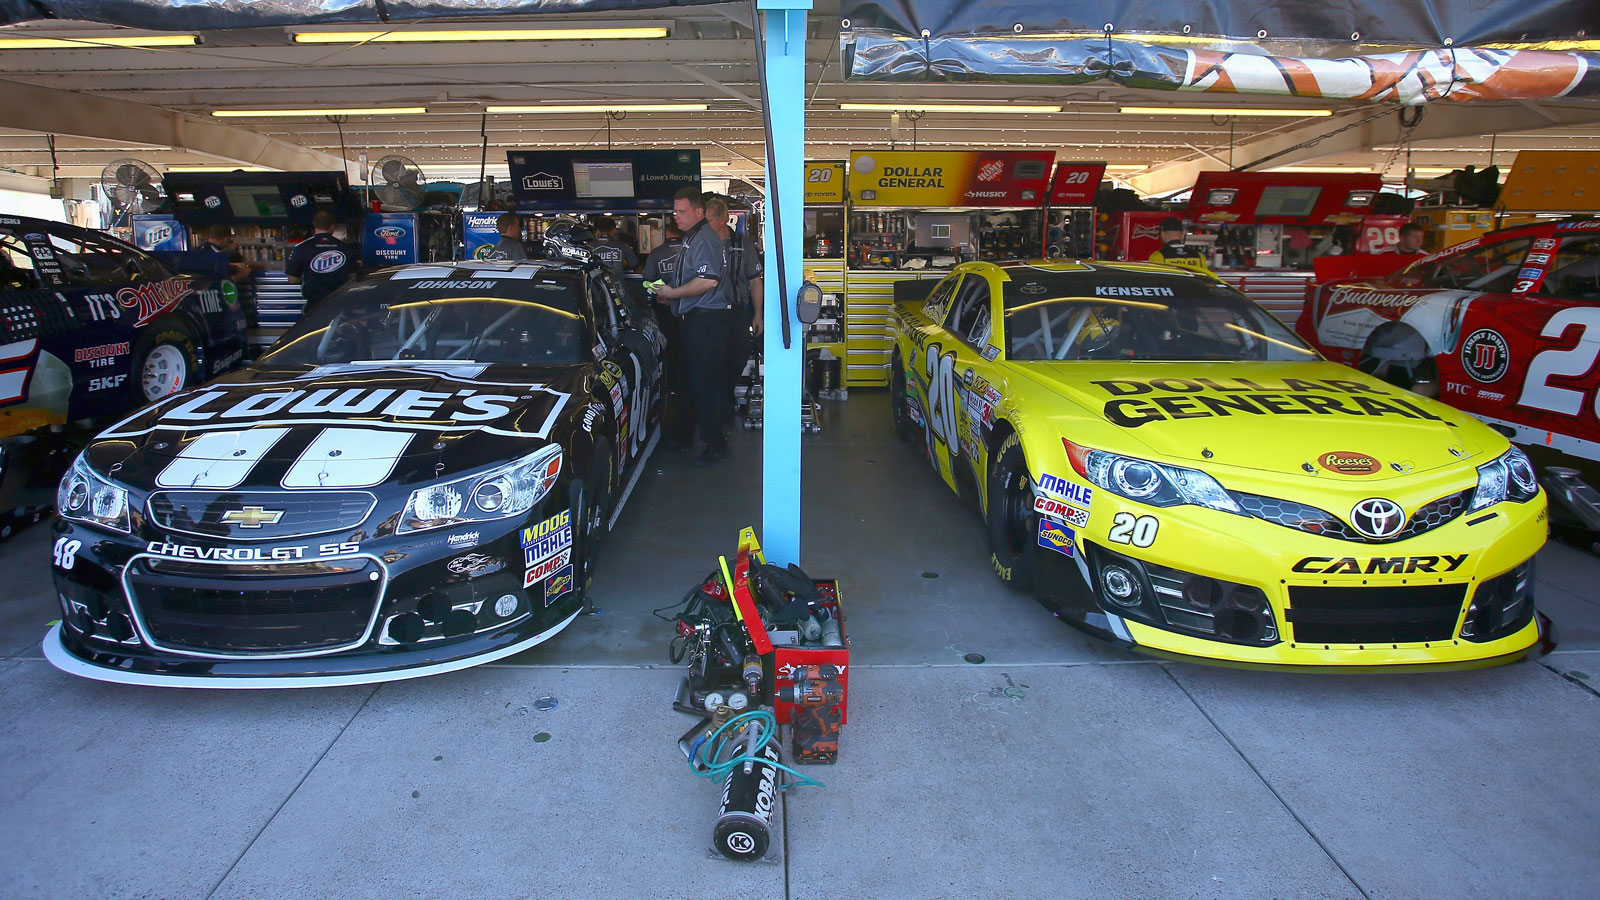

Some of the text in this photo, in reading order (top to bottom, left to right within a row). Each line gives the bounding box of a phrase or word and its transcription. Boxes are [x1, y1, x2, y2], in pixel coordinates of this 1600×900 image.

[669, 174, 693, 182] Racing
[808, 169, 832, 182] 20
[883, 167, 943, 177] DOLLAR
[1066, 172, 1090, 183] 20
[526, 178, 560, 188] LOWE'S
[878, 178, 945, 188] GENERAL
[380, 229, 399, 237] Ford
[1366, 227, 1400, 254] 29
[561, 247, 587, 257] KOBALT
[317, 254, 342, 270] Lite
[408, 281, 498, 289] JOHNSON
[1095, 286, 1174, 297] KENSETH
[1511, 281, 1534, 292] 3
[85, 280, 222, 322] IT'S Miller TIME
[75, 342, 130, 362] DISCOUNT
[1465, 332, 1486, 354] JIMMY
[90, 357, 115, 368] TIRE
[1474, 344, 1497, 369] JJ
[89, 374, 127, 391] SKF
[1090, 378, 1392, 396] DOLLAR
[1447, 382, 1471, 394] PTC
[158, 388, 520, 421] LOWE'S
[1103, 394, 1459, 428] GENERAL
[1325, 454, 1373, 466] Reese's
[1038, 472, 1092, 505] MAHLE
[1035, 497, 1075, 517] COMP
[523, 509, 570, 544] MOOG
[1108, 511, 1159, 548] 20
[447, 531, 480, 544] Hendrick
[526, 527, 571, 564] MAHLE
[1040, 530, 1074, 548] SUNOCO
[53, 537, 82, 570] 48
[147, 541, 360, 560] CHEVROLET SS
[527, 556, 561, 583] COMP
[1291, 553, 1469, 574] CAMRY
